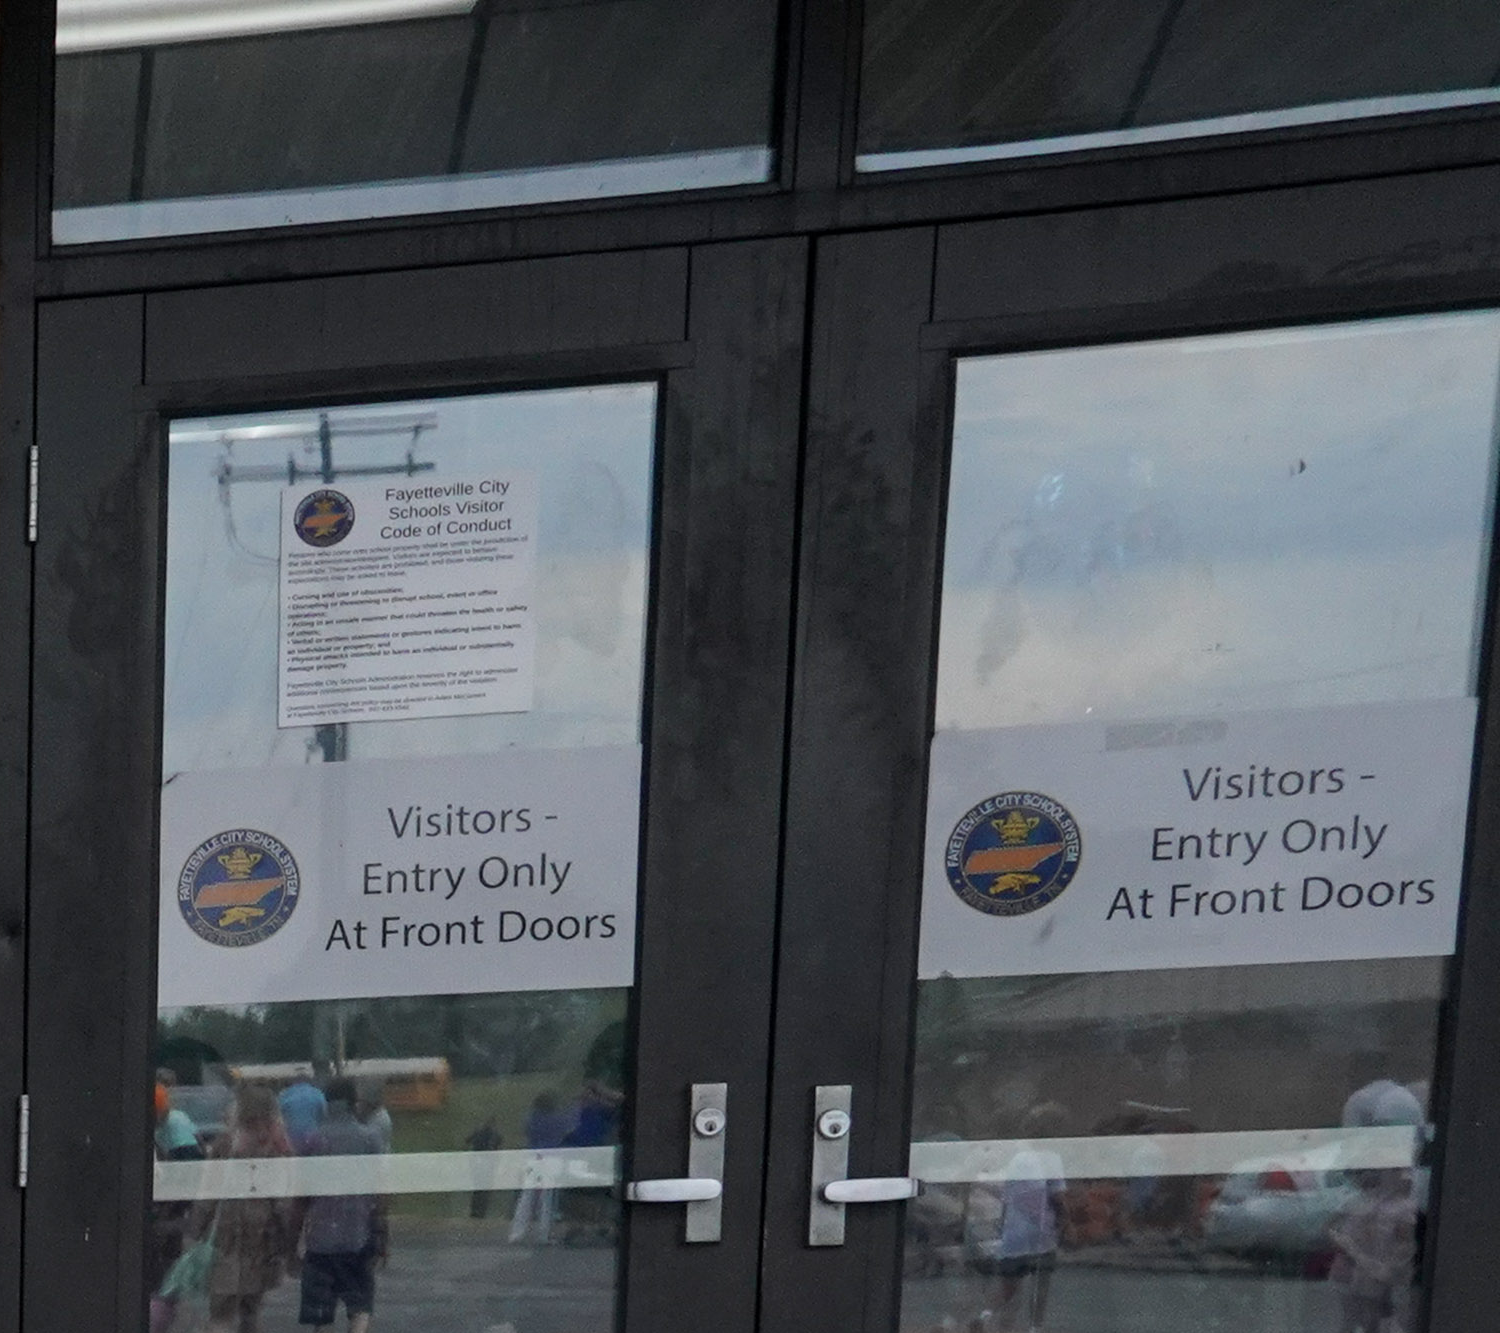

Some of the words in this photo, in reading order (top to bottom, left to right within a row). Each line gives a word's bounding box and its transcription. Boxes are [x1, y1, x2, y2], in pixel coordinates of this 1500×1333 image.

[385, 482, 474, 502] Fayetteville
[479, 480, 511, 496] City
[389, 503, 451, 520] Schools
[456, 500, 505, 515] Visitor
[380, 523, 422, 540] Code
[426, 521, 442, 536] of
[447, 517, 512, 535] Conduct
[1183, 764, 1345, 802] Visitors
[995, 794, 1023, 807] CITY
[220, 831, 245, 845] CITY
[388, 805, 532, 839] Visitors
[1151, 826, 1268, 866] Entry
[1281, 814, 1389, 858] Only
[363, 862, 465, 899] Entry
[478, 853, 572, 894] Only
[1106, 887, 1153, 921] At
[1169, 880, 1285, 918] Front
[1300, 874, 1436, 912] Doors
[325, 919, 368, 951] At
[381, 914, 485, 948] Front
[498, 911, 616, 943] Doors
